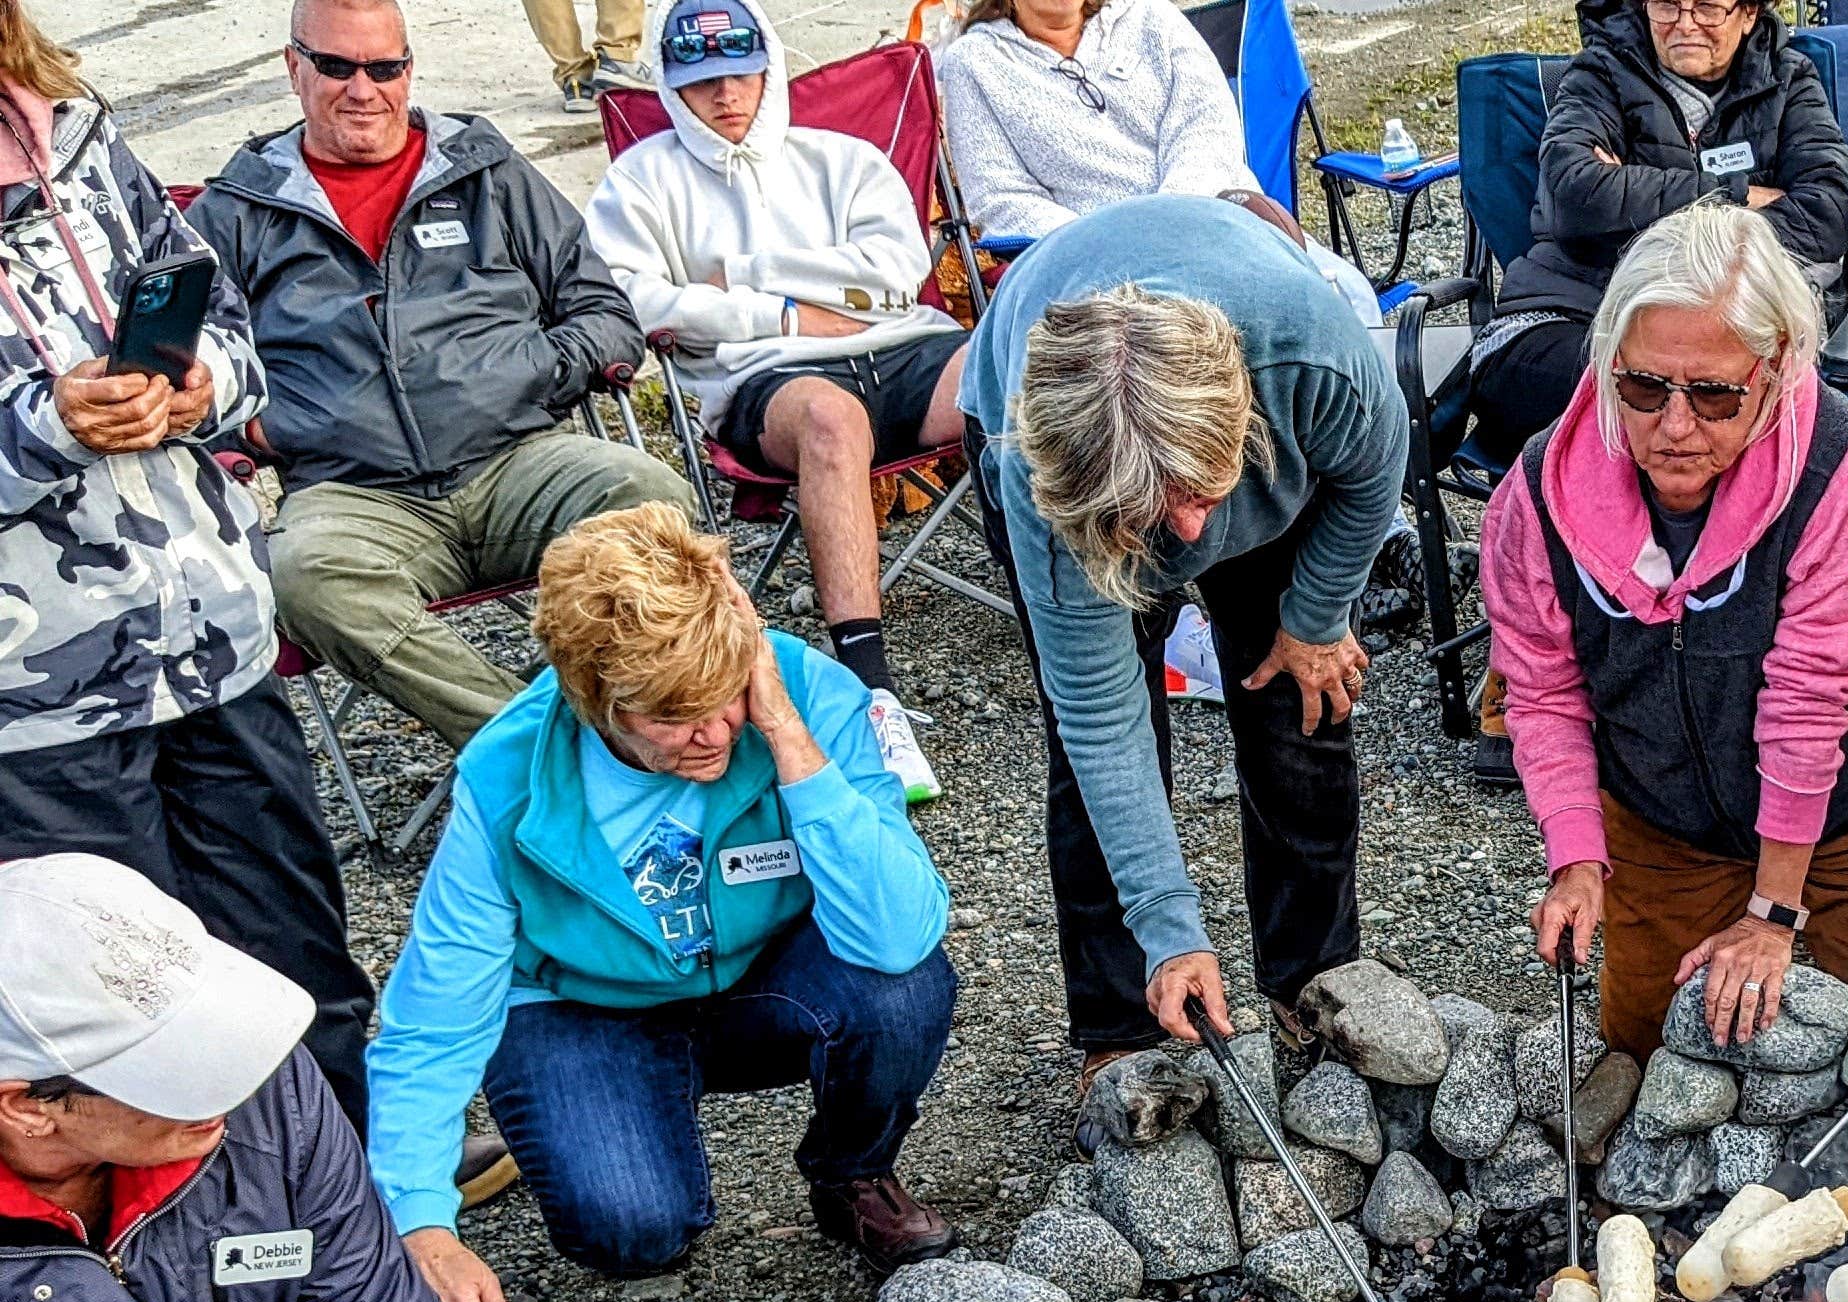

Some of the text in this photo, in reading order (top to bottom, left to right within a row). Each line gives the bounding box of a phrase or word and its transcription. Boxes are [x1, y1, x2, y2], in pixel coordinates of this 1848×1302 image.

[73, 218, 90, 233] ndi
[745, 849, 790, 865] Melinda
[756, 862, 787, 872] MISSOURI
[254, 1242, 303, 1260] Debbie
[254, 1258, 303, 1270] NEW JERSEY
